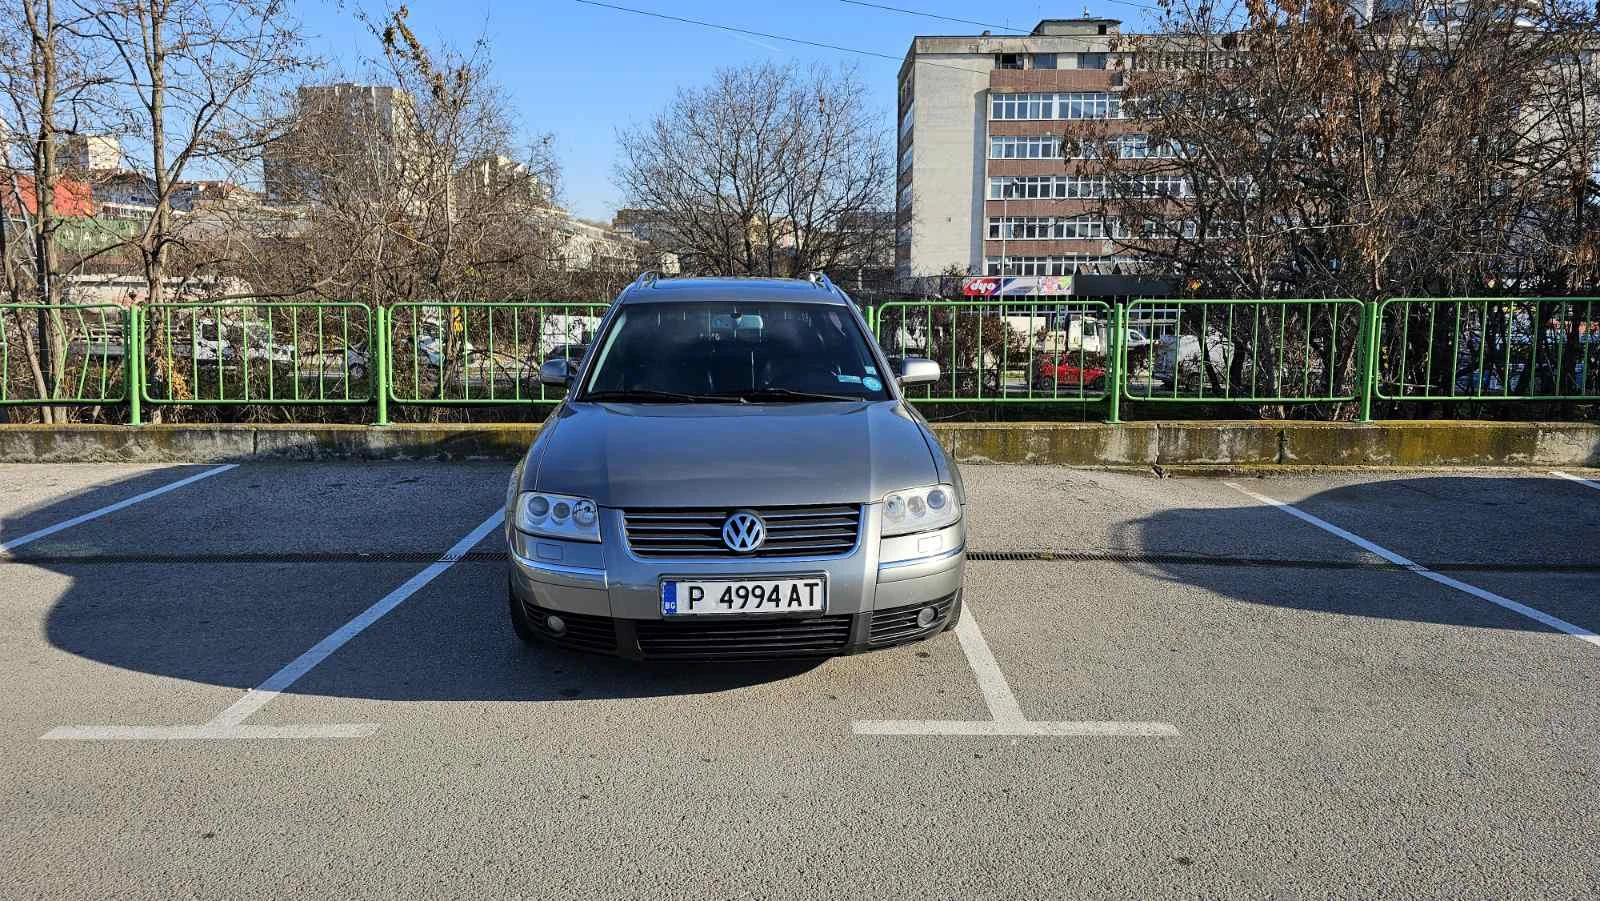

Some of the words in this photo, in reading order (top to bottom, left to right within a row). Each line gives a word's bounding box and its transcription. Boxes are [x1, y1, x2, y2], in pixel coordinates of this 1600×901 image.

[970, 280, 996, 294] dyo
[723, 511, 764, 552] VW
[688, 585, 705, 610] P
[719, 583, 782, 609] 4994
[787, 582, 819, 608] AT
